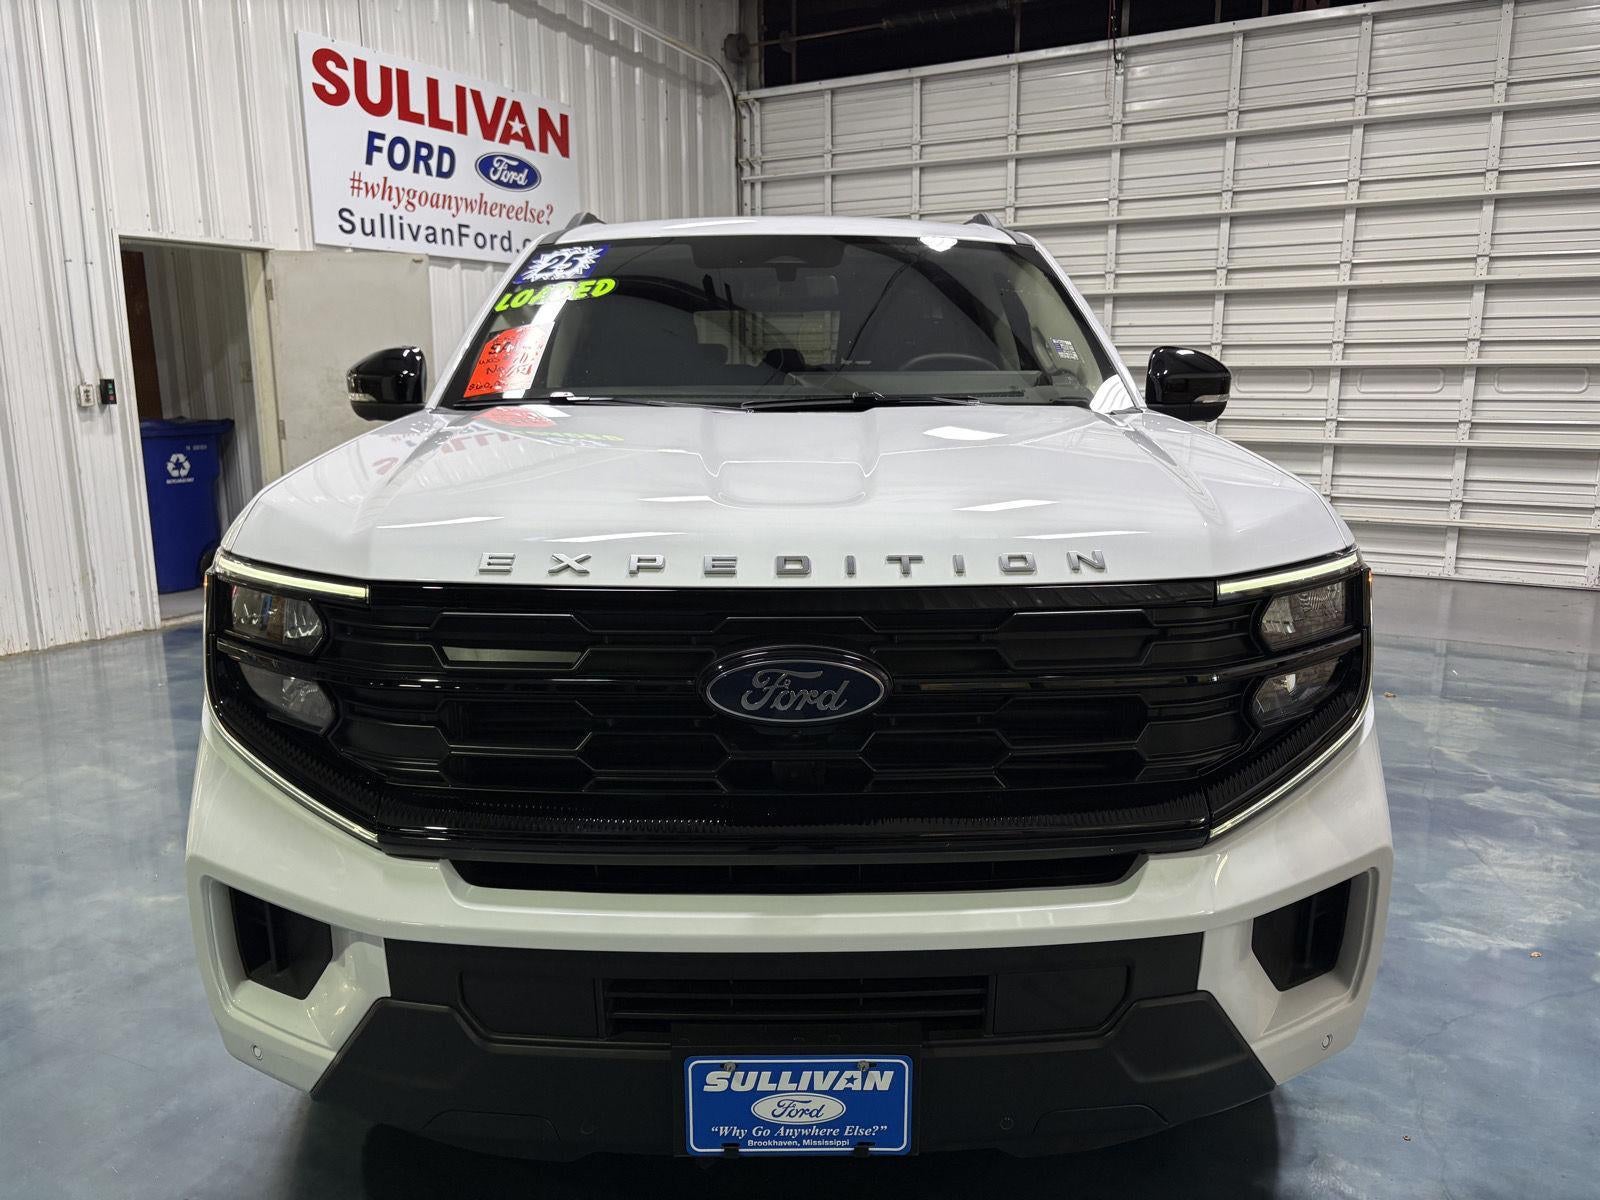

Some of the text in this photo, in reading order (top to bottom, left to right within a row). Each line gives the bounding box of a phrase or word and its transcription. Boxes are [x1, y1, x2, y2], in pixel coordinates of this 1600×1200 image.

[312, 48, 570, 159] SULLIVAN
[365, 130, 456, 179] FORD
[489, 156, 529, 186] Ford
[349, 170, 554, 226] #whygoanywhereelse?
[535, 253, 586, 274] 25
[477, 549, 1108, 578] EXPEDITION
[740, 667, 848, 712] Ford
[703, 1070, 894, 1092] SULLIVAN
[771, 1098, 824, 1119] Ford
[747, 1138, 850, 1147] Brookhaven, Mississippi
[752, 1125, 771, 1137] Go
[774, 1125, 840, 1139] Anywhere
